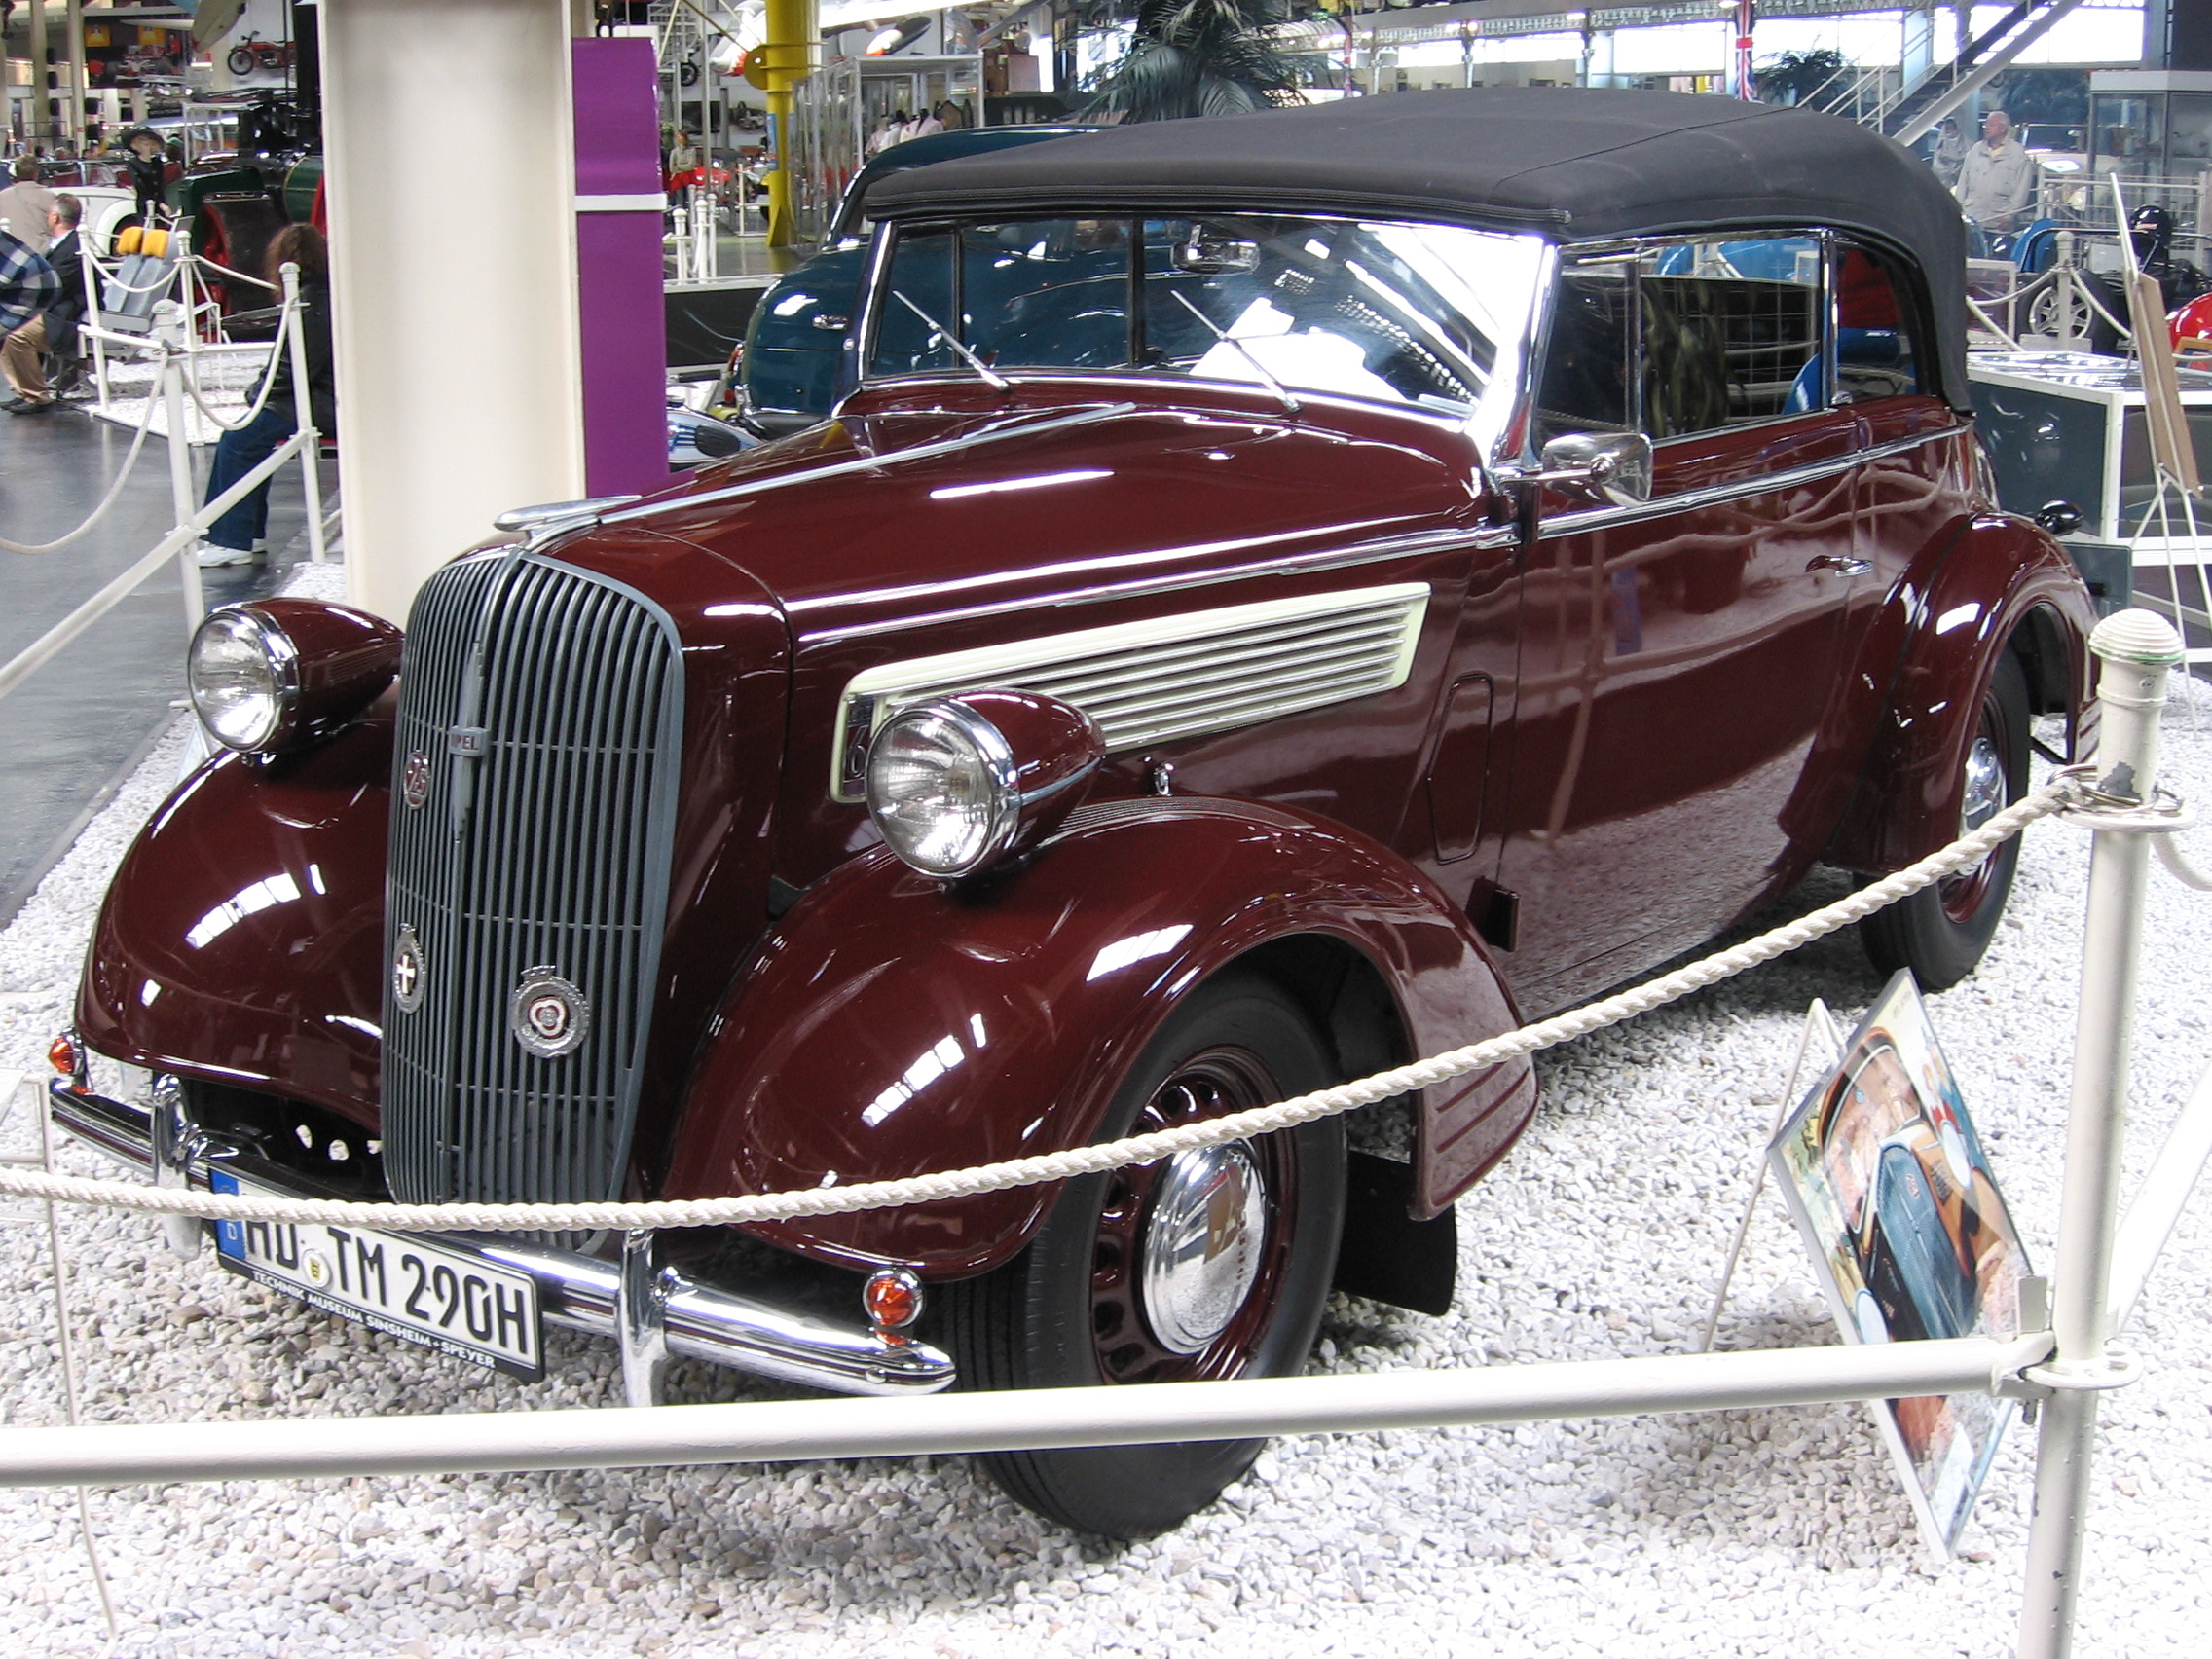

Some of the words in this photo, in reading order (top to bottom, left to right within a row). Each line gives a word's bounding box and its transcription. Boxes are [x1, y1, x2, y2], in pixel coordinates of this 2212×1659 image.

[252, 1271, 305, 1300] TECHNIK
[307, 1293, 363, 1323] MUSEUM
[366, 1315, 432, 1347] SINSHEIM
[440, 1341, 496, 1369] SPEYER
[327, 1226, 387, 1307] TM
[402, 1253, 528, 1354] 290H
